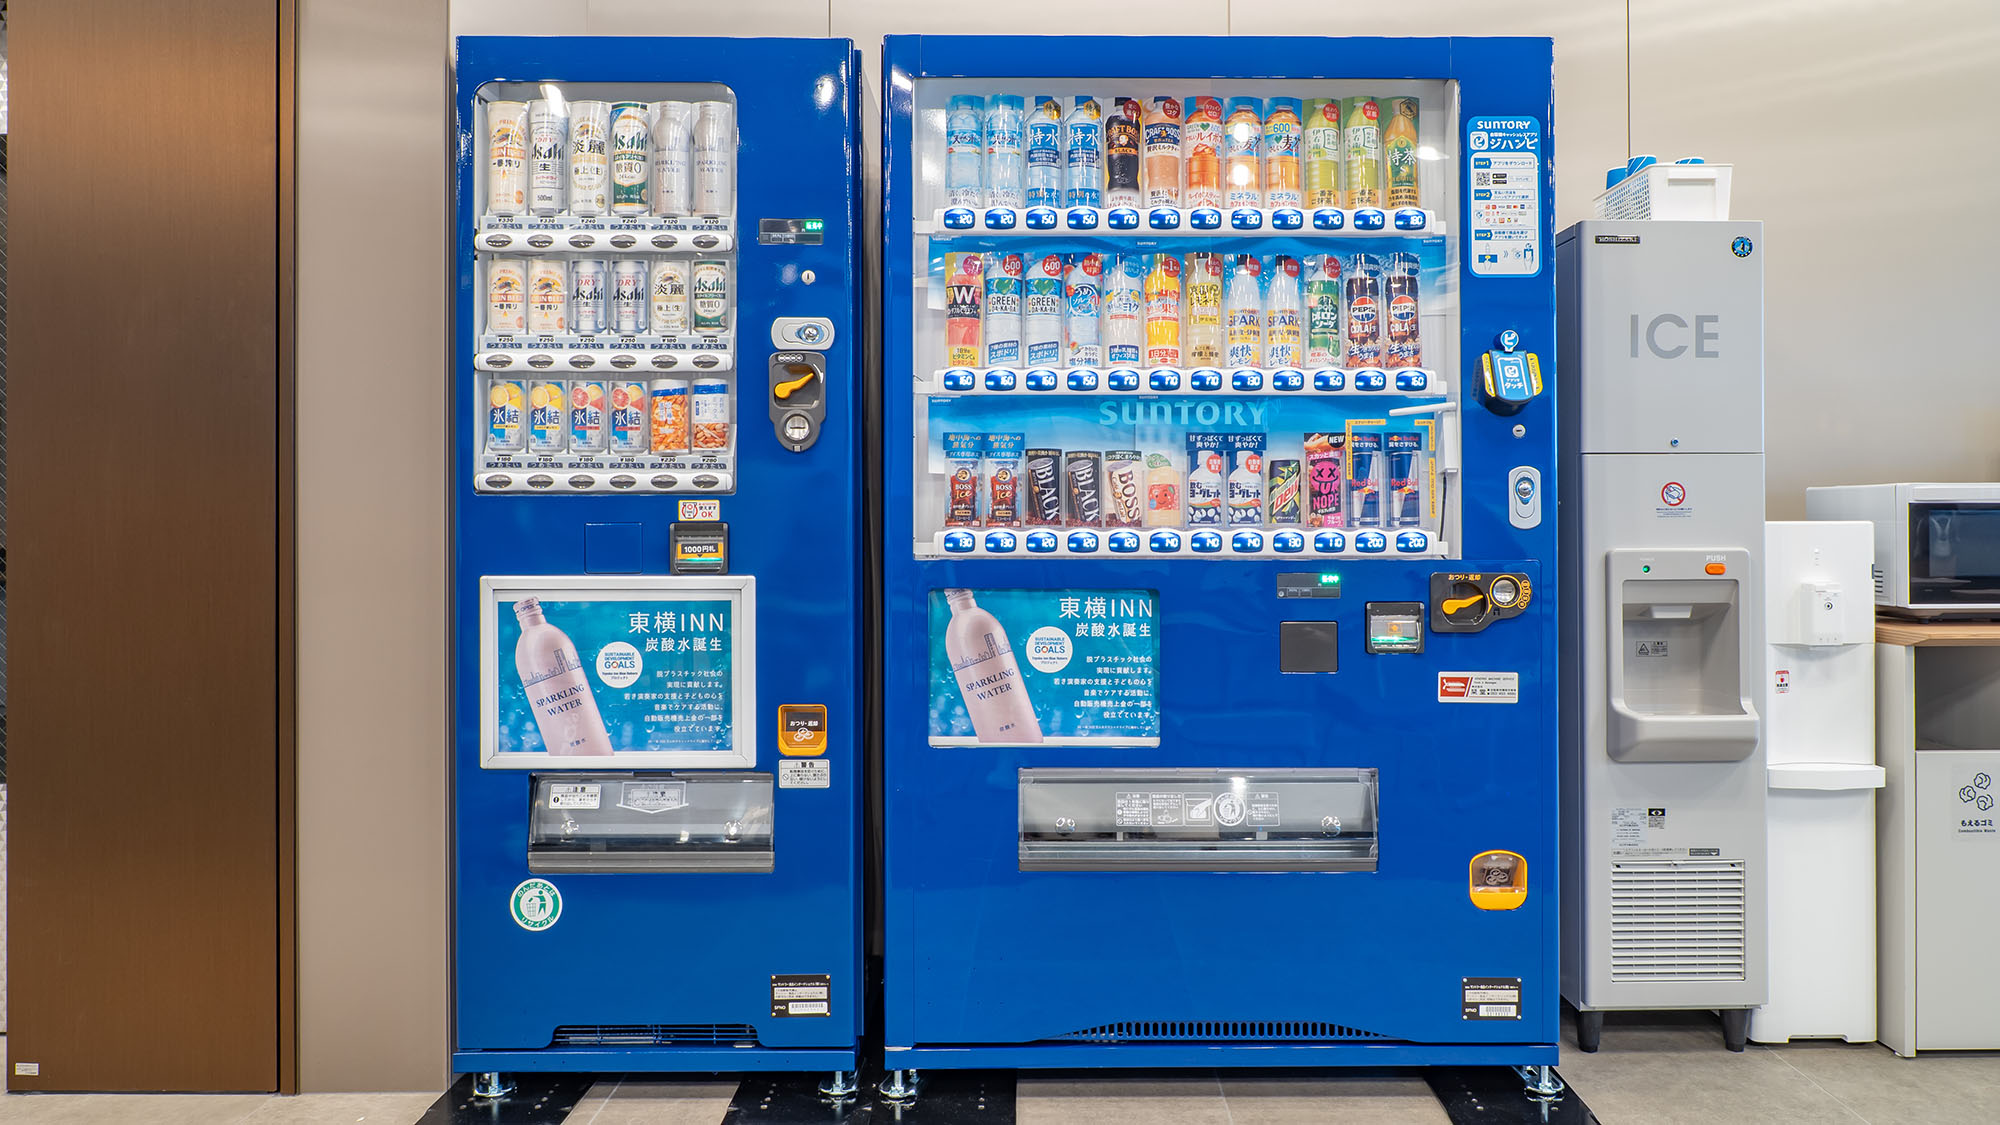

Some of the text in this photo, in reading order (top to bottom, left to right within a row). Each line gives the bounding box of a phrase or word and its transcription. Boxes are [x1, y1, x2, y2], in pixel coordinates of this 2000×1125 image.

[1273, 122, 1291, 133] 600
[1477, 120, 1531, 130] SUNTORY
[1028, 127, 1059, 146] 特水
[1067, 127, 1100, 146] 特水
[572, 141, 605, 155] 淡麗
[1490, 138, 1539, 150] ジハンピ
[1389, 148, 1417, 166] 特茶
[537, 194, 553, 202] 500ml
[1004, 261, 1021, 270] 600
[1044, 261, 1061, 271] 600
[654, 283, 684, 295] 淡麗
[694, 277, 725, 292] Asahi
[572, 286, 603, 301] Asahi
[613, 286, 644, 301] Asahi
[953, 286, 976, 304] W
[1075, 287, 1093, 297] うめ
[700, 300, 720, 308] 糖質0
[991, 296, 1016, 306] GREEN
[1031, 296, 1056, 306] GREEN
[1190, 296, 1219, 306] レモネード
[1229, 314, 1261, 327] SPARK
[1267, 314, 1300, 328] SPARK
[1315, 319, 1336, 329] ソーダ
[1350, 325, 1369, 334] COLA
[1390, 323, 1409, 333] COLA
[1504, 333, 1516, 346] ピ
[1629, 313, 1720, 359] ICE
[1229, 344, 1252, 358] 爽快
[1268, 344, 1291, 358] 爽快
[1069, 357, 1099, 366] 塩分補給
[1230, 357, 1252, 367] レモン
[1269, 357, 1290, 367] レモン
[493, 408, 519, 424] 氷結
[534, 409, 560, 425] 氷結
[575, 410, 600, 425] 氷結
[1099, 399, 1267, 427] SUNTORY
[615, 411, 641, 426] 氷結
[1189, 434, 1223, 442] 甘ずっぱくて
[1228, 434, 1262, 442] 甘ずっぱくて
[1328, 435, 1345, 444] NEW
[1195, 441, 1220, 449] 爽やか!
[1234, 441, 1259, 449] 爽やか!
[1190, 481, 1203, 490] 飲む
[1229, 481, 1242, 490] 飲む
[1352, 477, 1366, 487] Red
[1391, 478, 1406, 487] Red
[956, 489, 972, 499] Ice
[996, 490, 1012, 500] Ice
[1035, 464, 1060, 521] BLACK
[1075, 466, 1100, 522] BLACK
[1118, 470, 1140, 521] BOSS
[1190, 488, 1221, 499] ヨーグレット
[1229, 488, 1260, 499] ヨーグレット
[1313, 493, 1340, 511] NOPE
[1367, 538, 1383, 548] 200
[1408, 538, 1424, 548] 200
[684, 545, 716, 553] 1000円札
[1059, 596, 1153, 619] 東横INN
[628, 611, 724, 634] 東横INN
[1075, 622, 1152, 637] 炭酸水誕生
[645, 636, 722, 652] 炭酸水誕生
[1034, 645, 1066, 653] GOALS
[1086, 655, 1153, 663] 脱プラスチック社会の
[604, 660, 636, 669] GOALS
[656, 670, 723, 678] 脱プラスチック社会の
[1096, 666, 1152, 674] 実現に貢献します。
[966, 668, 1015, 692] SPARKLING
[1053, 677, 1153, 686] 若き演奏家の支援と子どもの心を
[536, 684, 585, 708] SPARKLING
[624, 692, 723, 700] 若き演奏家の支援と子どもの心を
[976, 683, 1013, 701] WATER
[1084, 689, 1153, 697] 音楽でケアする活動に、
[547, 698, 583, 717] WATER
[654, 703, 723, 711] 音楽でケアする活動に、
[1074, 700, 1153, 708] 自動販売機売上金の一部を
[644, 714, 723, 722] 自動販売機売上金の一部を
[1961, 819, 1994, 827] もえるゴミ
[522, 915, 555, 929] リサイクル
